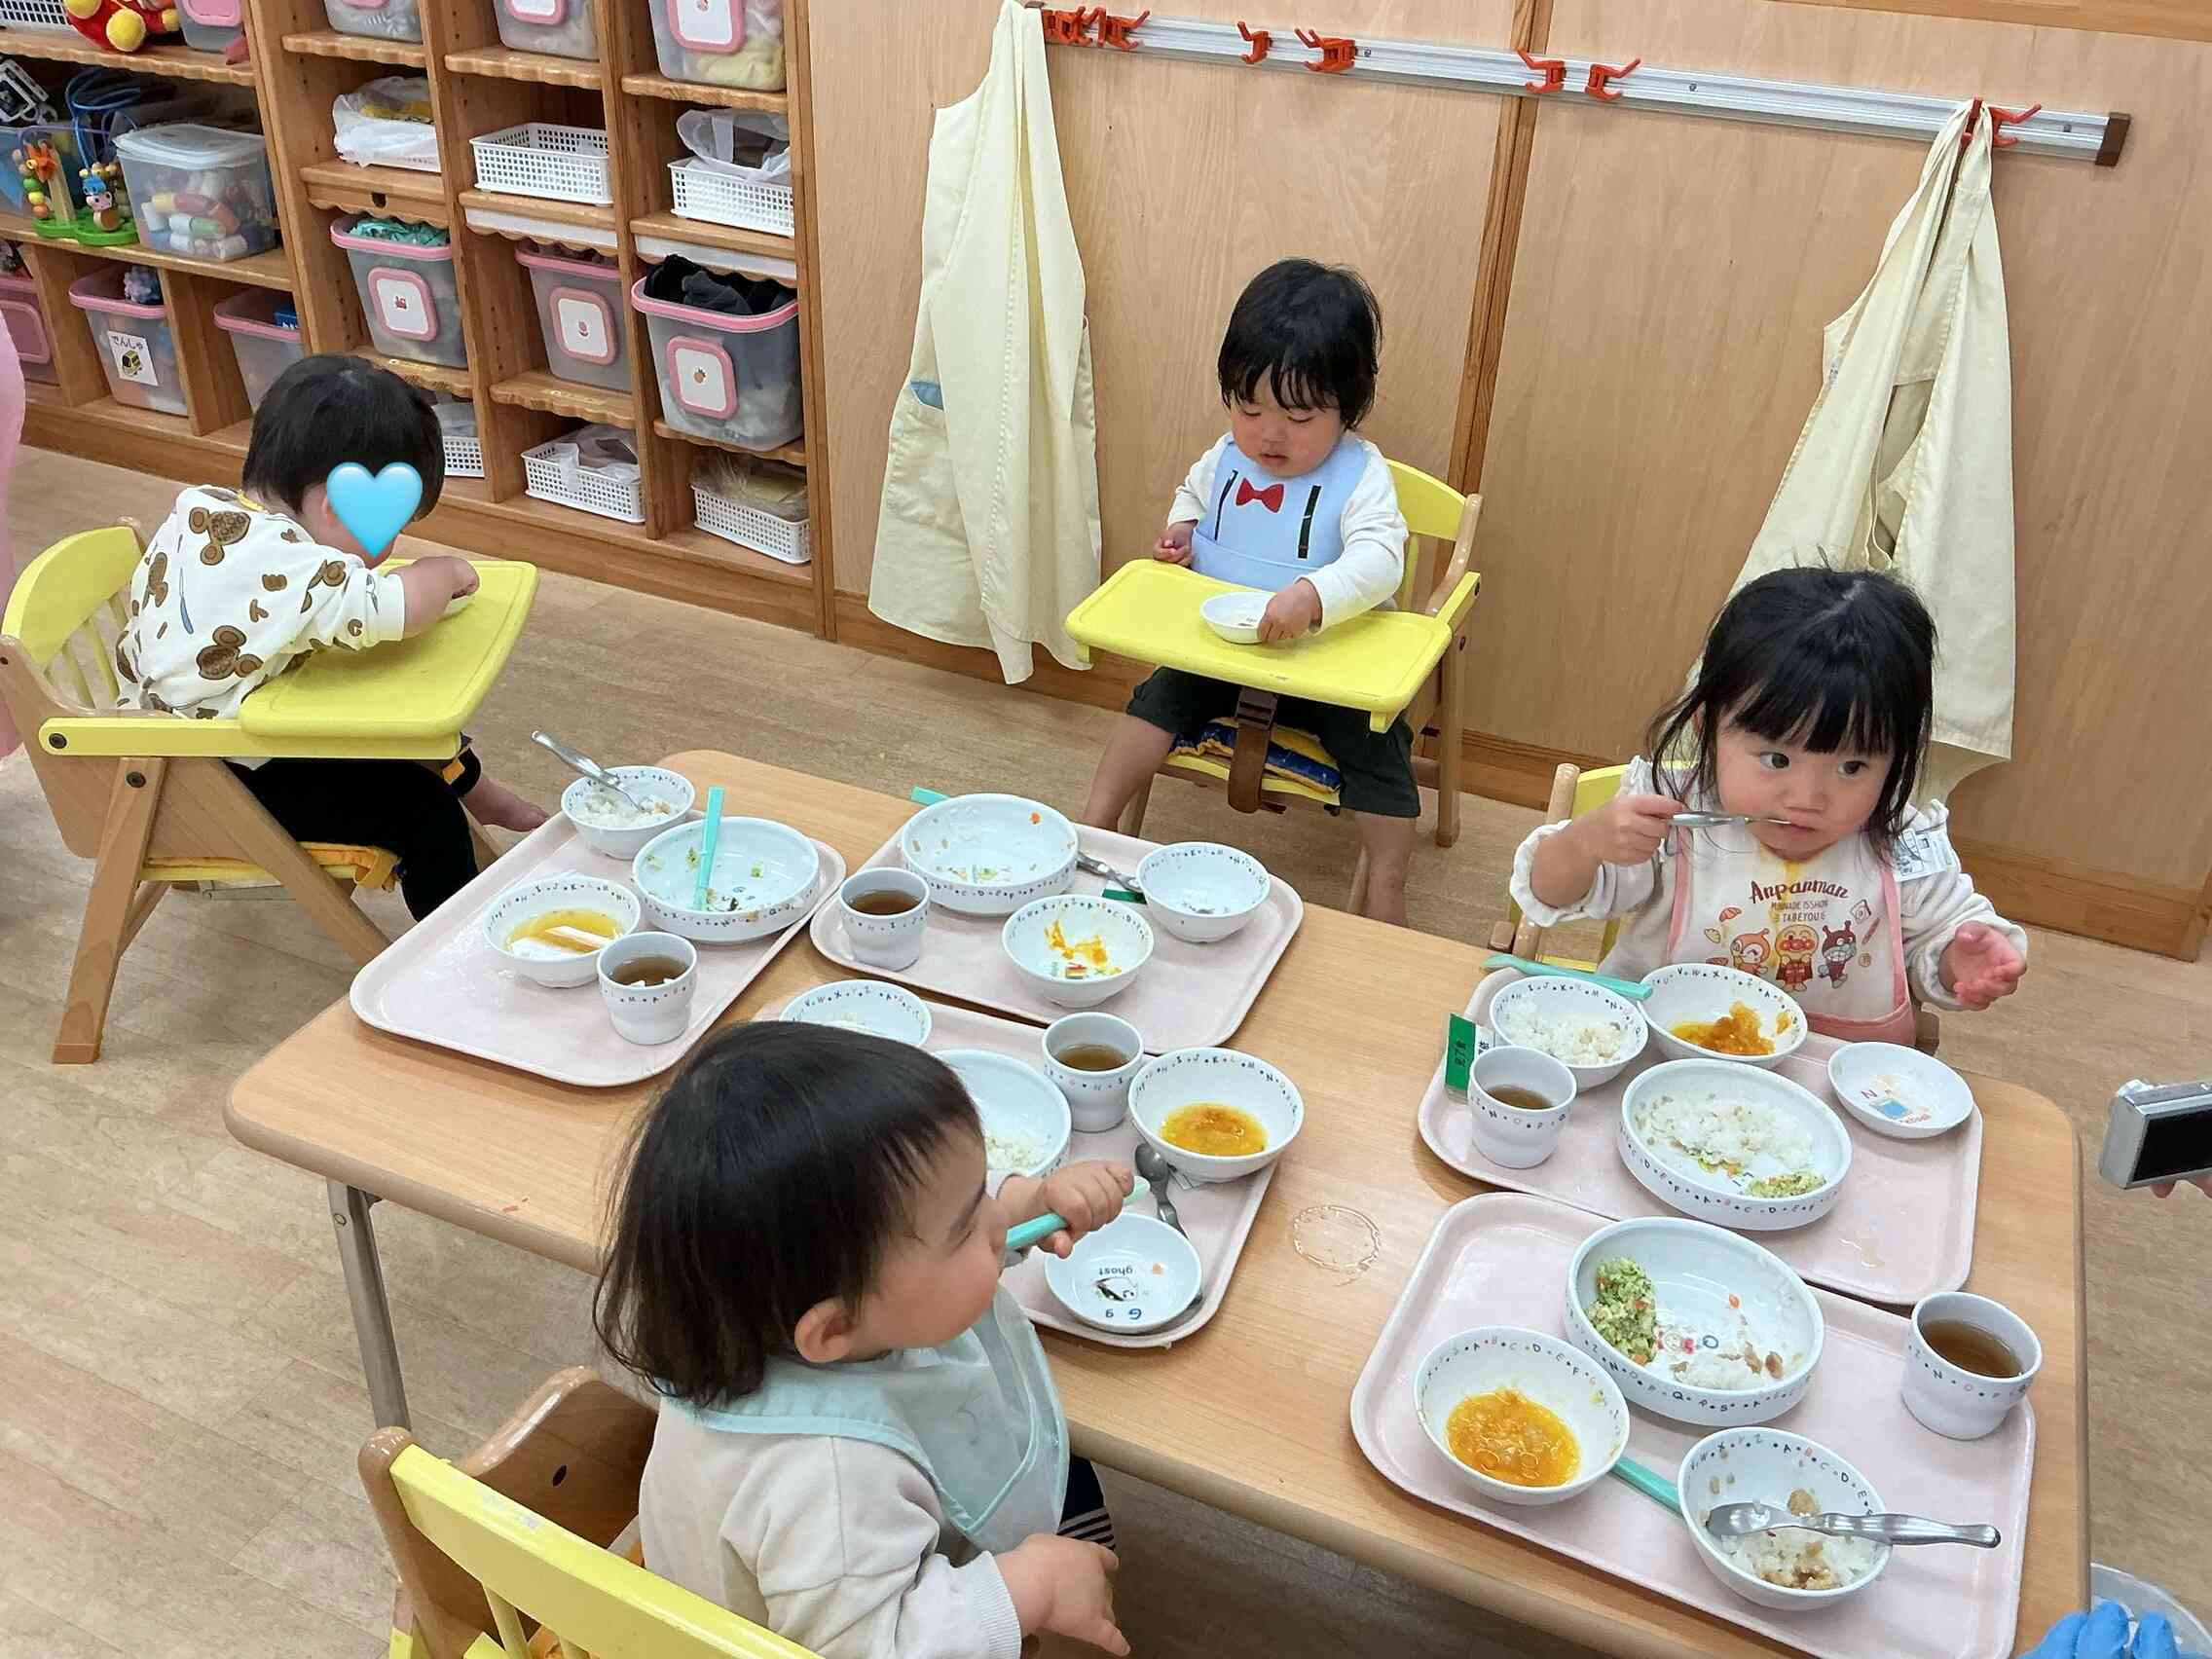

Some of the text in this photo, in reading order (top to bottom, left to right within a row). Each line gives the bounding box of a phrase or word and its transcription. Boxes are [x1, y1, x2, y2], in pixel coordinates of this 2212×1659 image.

[1749, 879, 1850, 904] Anpanman
[1098, 1264, 1133, 1276] ghost
[1127, 1308, 1143, 1321] G
